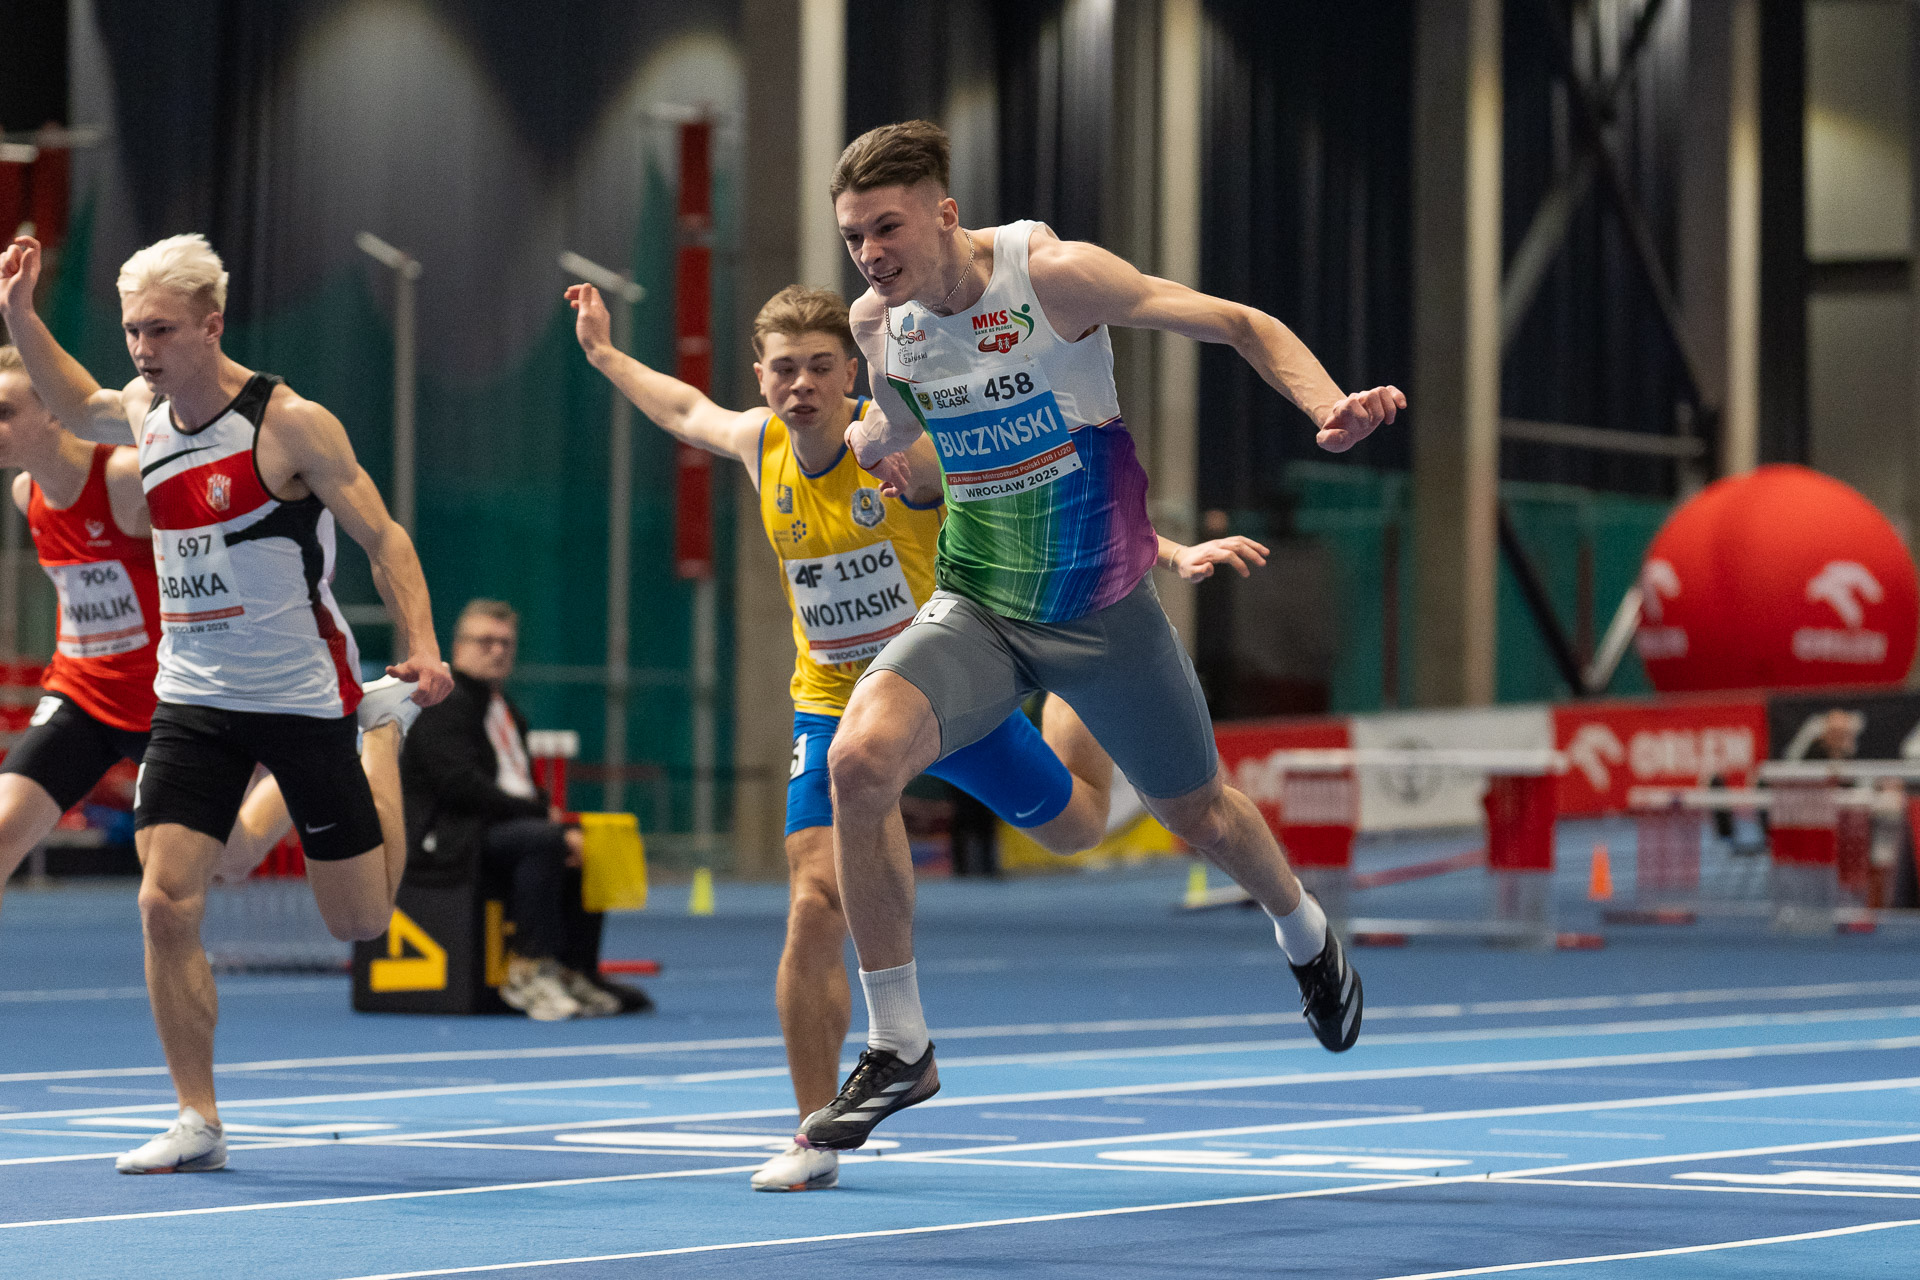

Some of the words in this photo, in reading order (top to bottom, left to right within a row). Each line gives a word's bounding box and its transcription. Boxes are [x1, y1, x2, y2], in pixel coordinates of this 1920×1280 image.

[971, 309, 1008, 331] MKS
[932, 384, 969, 400] DOLNY
[983, 372, 1034, 402] 458
[936, 395, 970, 410] ŚLĄSK
[936, 405, 1058, 458] BUCZYŃSKI
[949, 473, 962, 483] PZLA
[981, 465, 1020, 481] Mistrzostwa
[1019, 459, 1041, 474] Polski
[1040, 453, 1054, 465] U18
[1057, 445, 1072, 456] U20
[965, 481, 1026, 498] WROCŁAW
[1026, 466, 1060, 486] 2025
[177, 534, 212, 558] 697
[81, 566, 120, 587] 906
[794, 563, 824, 588] 4F
[834, 548, 895, 582] 1106
[158, 572, 230, 599] ABAKA
[65, 595, 136, 624] WALIK
[799, 583, 908, 628] WOJTASIK
[826, 645, 879, 662] WROCŁAW
